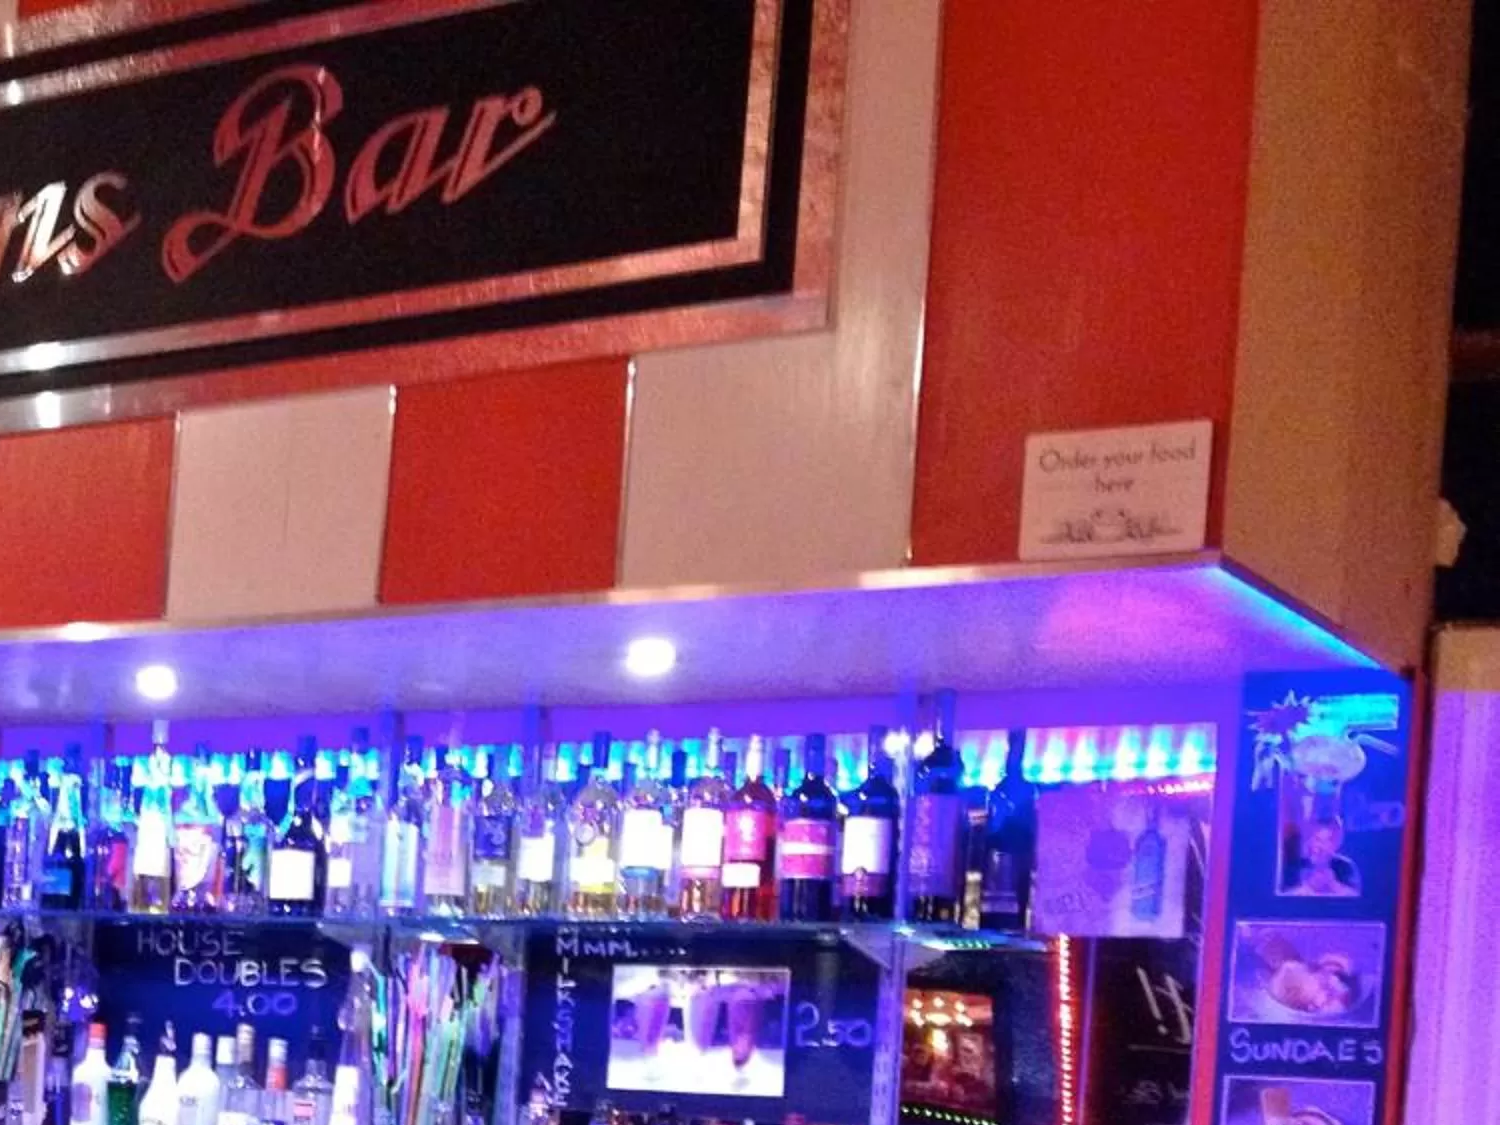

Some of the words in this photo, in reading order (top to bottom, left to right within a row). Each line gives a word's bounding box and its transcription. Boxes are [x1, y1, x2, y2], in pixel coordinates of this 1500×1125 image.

[162, 64, 557, 284] Bar
[1103, 450, 1145, 471] your
[137, 926, 245, 957] HOUSE
[173, 957, 327, 989] DOUBLES
[212, 989, 298, 1018] 4.00
[794, 1002, 872, 1049] 2.50
[1229, 1028, 1383, 1065] SUNDAES
